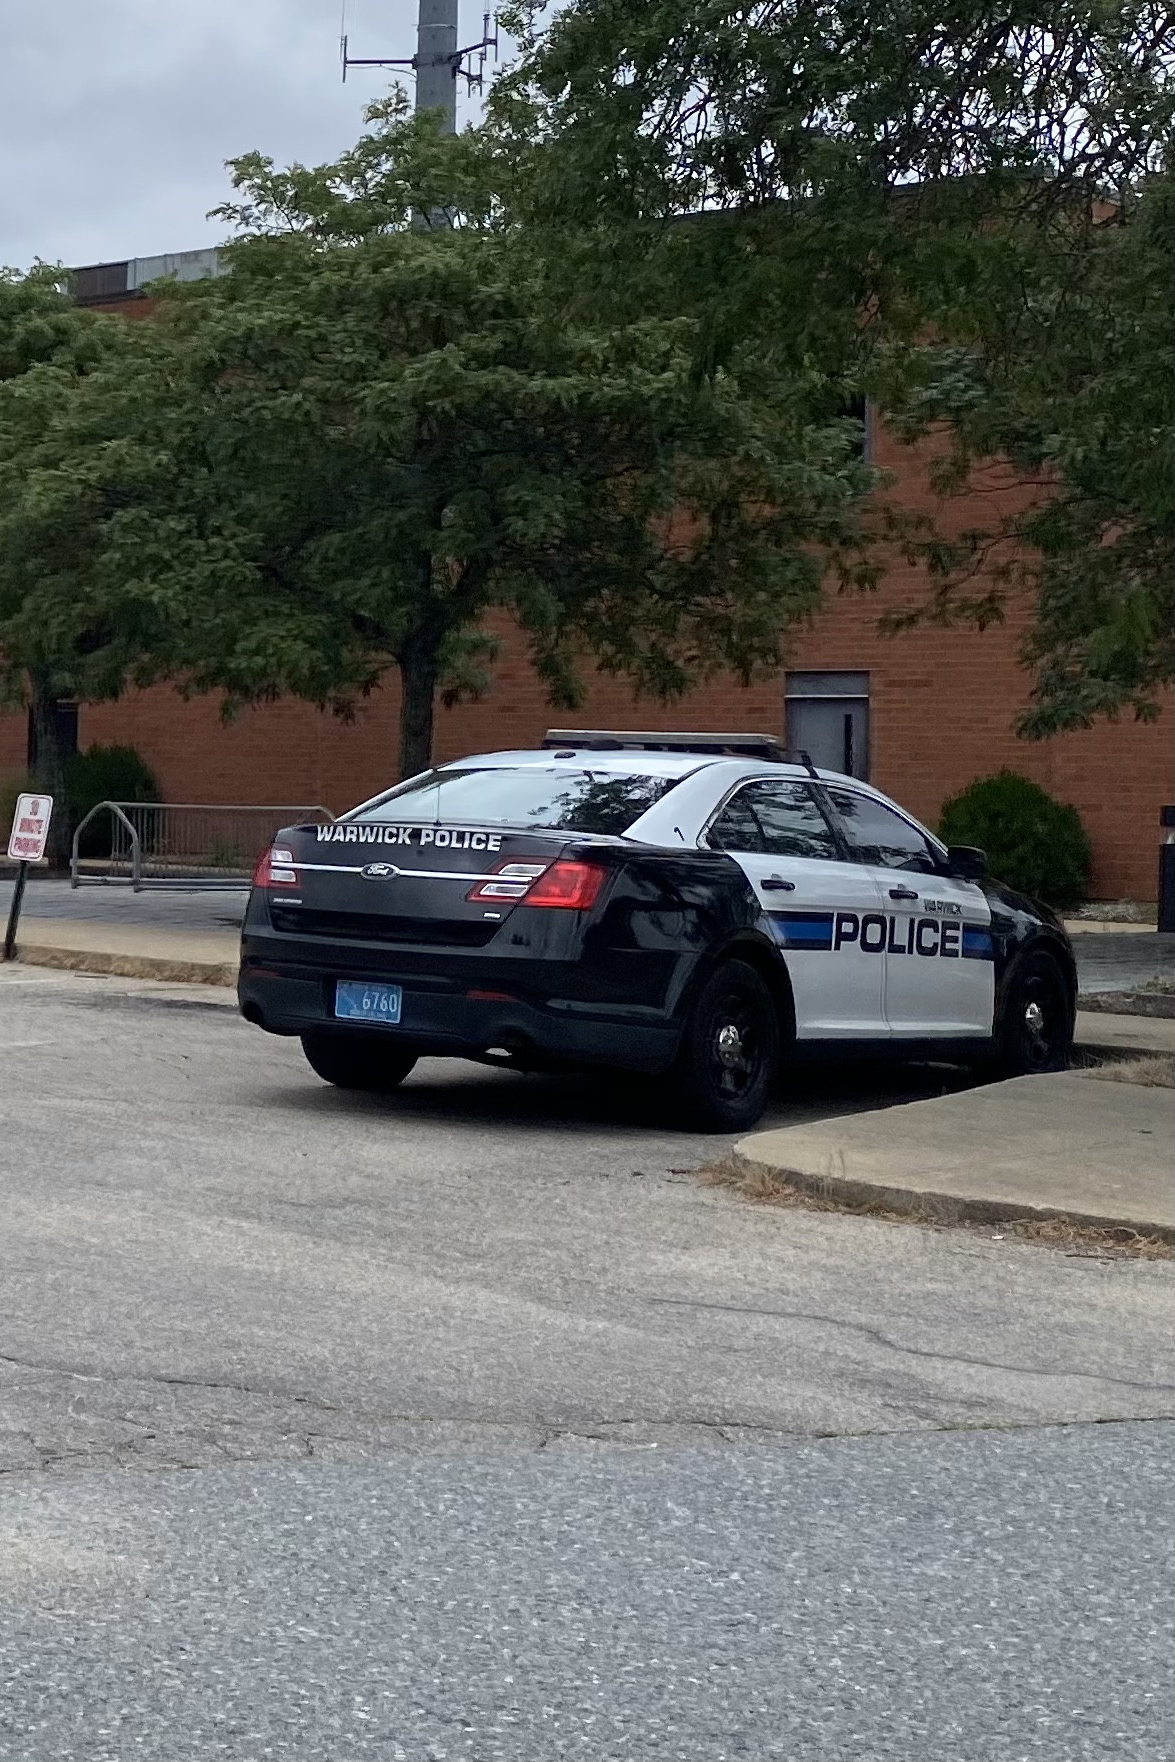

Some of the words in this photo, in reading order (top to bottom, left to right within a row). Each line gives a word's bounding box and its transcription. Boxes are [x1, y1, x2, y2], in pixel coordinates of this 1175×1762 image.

[316, 825, 412, 846] WARWICK
[420, 829, 502, 851] POLICE
[834, 912, 960, 958] POLICE
[362, 991, 398, 1013] 6760
